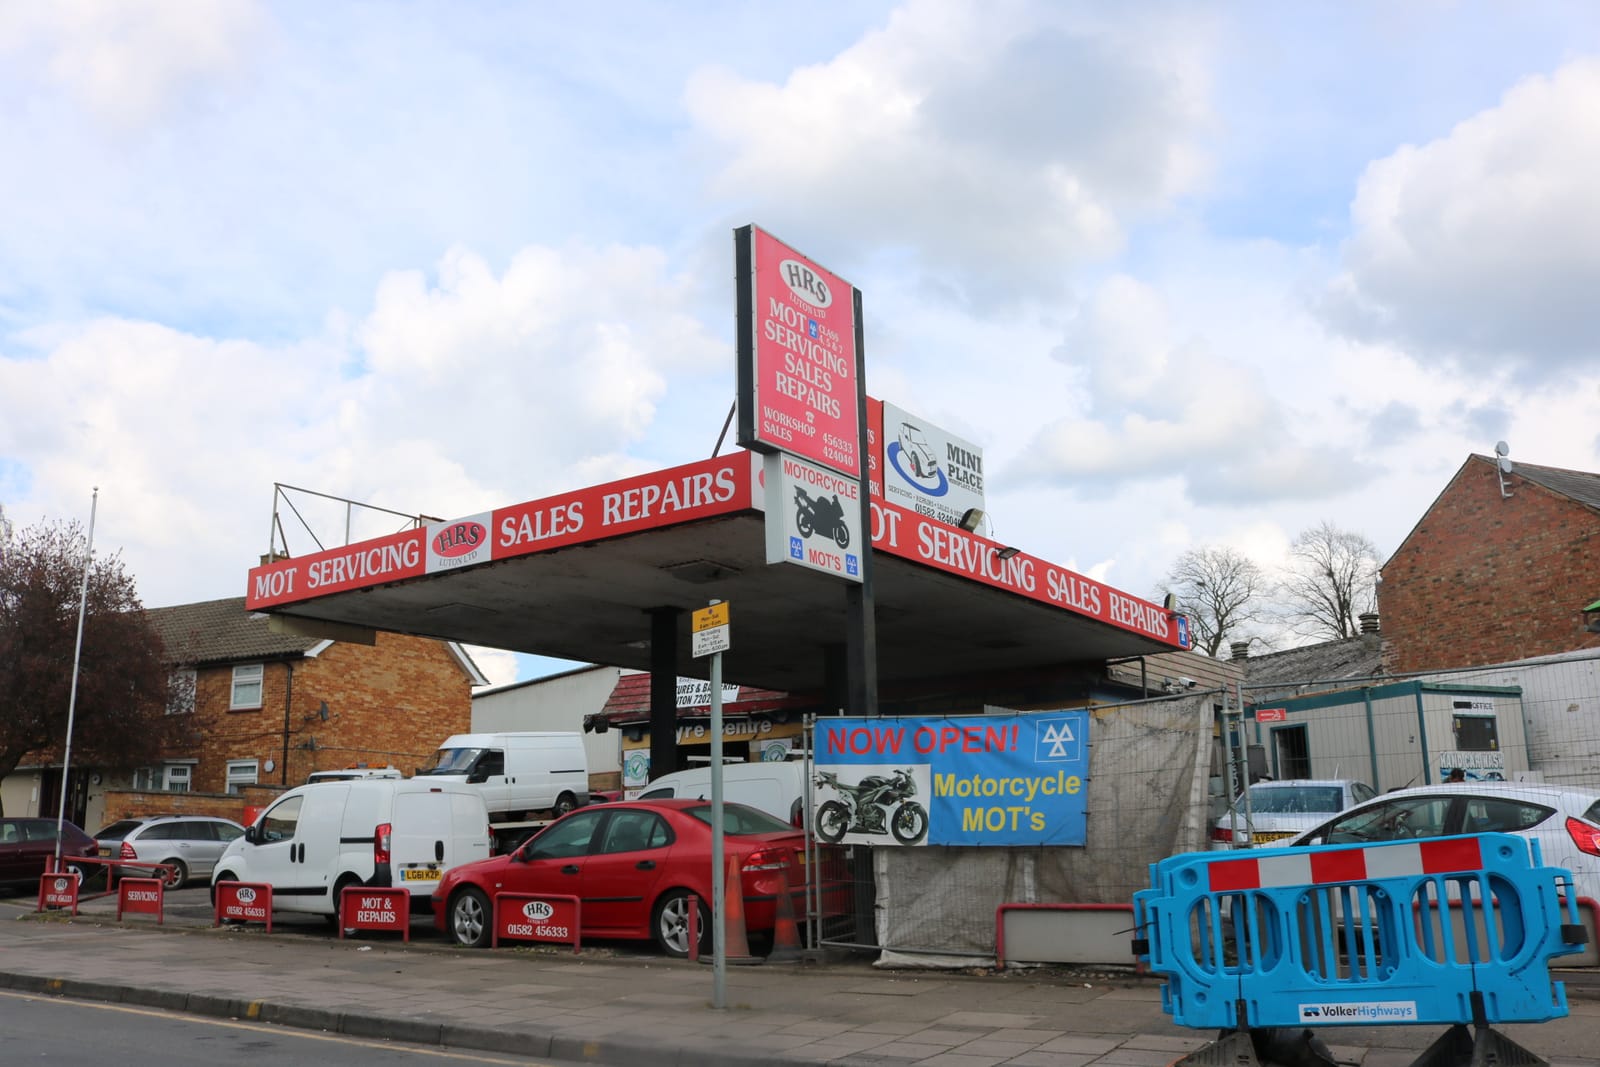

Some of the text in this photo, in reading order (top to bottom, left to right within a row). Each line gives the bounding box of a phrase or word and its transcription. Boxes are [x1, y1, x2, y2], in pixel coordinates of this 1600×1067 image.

[787, 264, 827, 303] HRS
[769, 297, 807, 333] MOT
[764, 319, 848, 378] SERVICING
[785, 352, 832, 392] SALES
[775, 371, 841, 420] REPAIRS
[763, 406, 816, 437] WORKSHOP
[763, 421, 792, 442] SALES
[823, 433, 853, 454] 456333
[823, 446, 854, 467] 424040
[946, 442, 982, 474] MINI
[783, 459, 857, 500] MOTORCYCLE
[947, 463, 983, 490] PLACE
[500, 467, 736, 547] SALES REPAIRS
[915, 503, 935, 519] 01582
[438, 524, 479, 554] HRS
[255, 539, 419, 600] MOT SERVICING
[808, 549, 842, 571] MOT'S
[917, 521, 1036, 592] SERVICING
[1047, 568, 1101, 615] SALES
[1109, 592, 1168, 638] REPAIRS
[827, 725, 1019, 754] NOW OPEN!
[934, 771, 1081, 802] Motorcycle
[962, 806, 1046, 832] MOT's
[406, 871, 440, 880] LG61 KZP
[128, 891, 158, 901] SERVICING
[239, 889, 254, 900] HRS
[361, 897, 392, 909] MOT &
[357, 910, 396, 923] REPAIRS
[527, 903, 551, 916] HRS
[508, 924, 568, 938] 01582 456333
[1321, 1005, 1413, 1018] VolkerHighways
